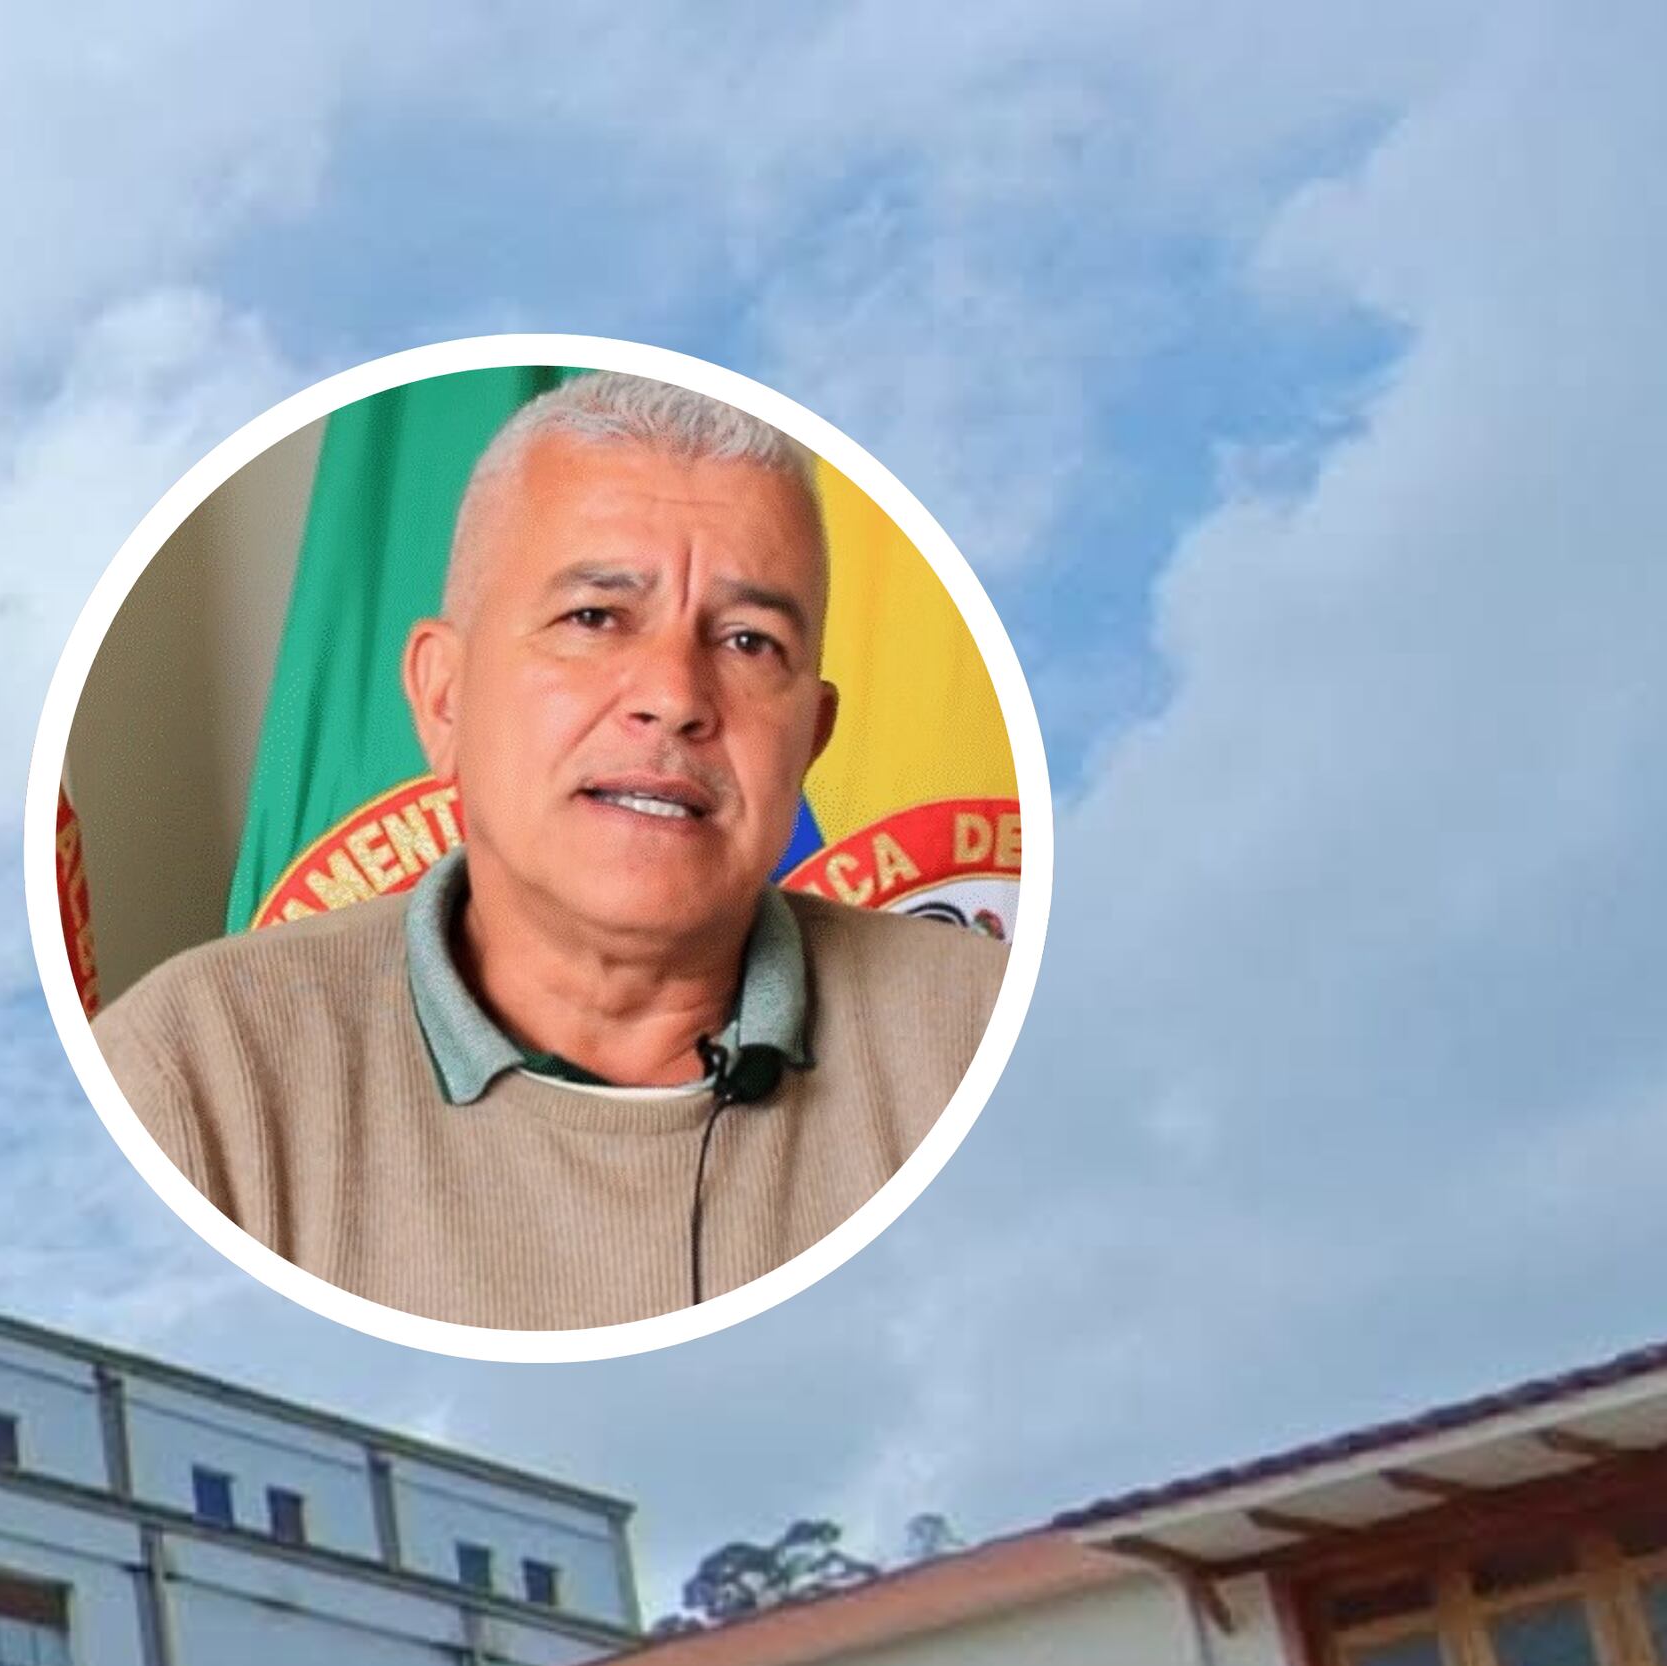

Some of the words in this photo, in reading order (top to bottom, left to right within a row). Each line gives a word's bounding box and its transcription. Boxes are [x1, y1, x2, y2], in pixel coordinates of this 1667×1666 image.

[270, 786, 460, 926] MENT
[803, 832, 921, 907] CA
[952, 812, 1021, 868] DE
